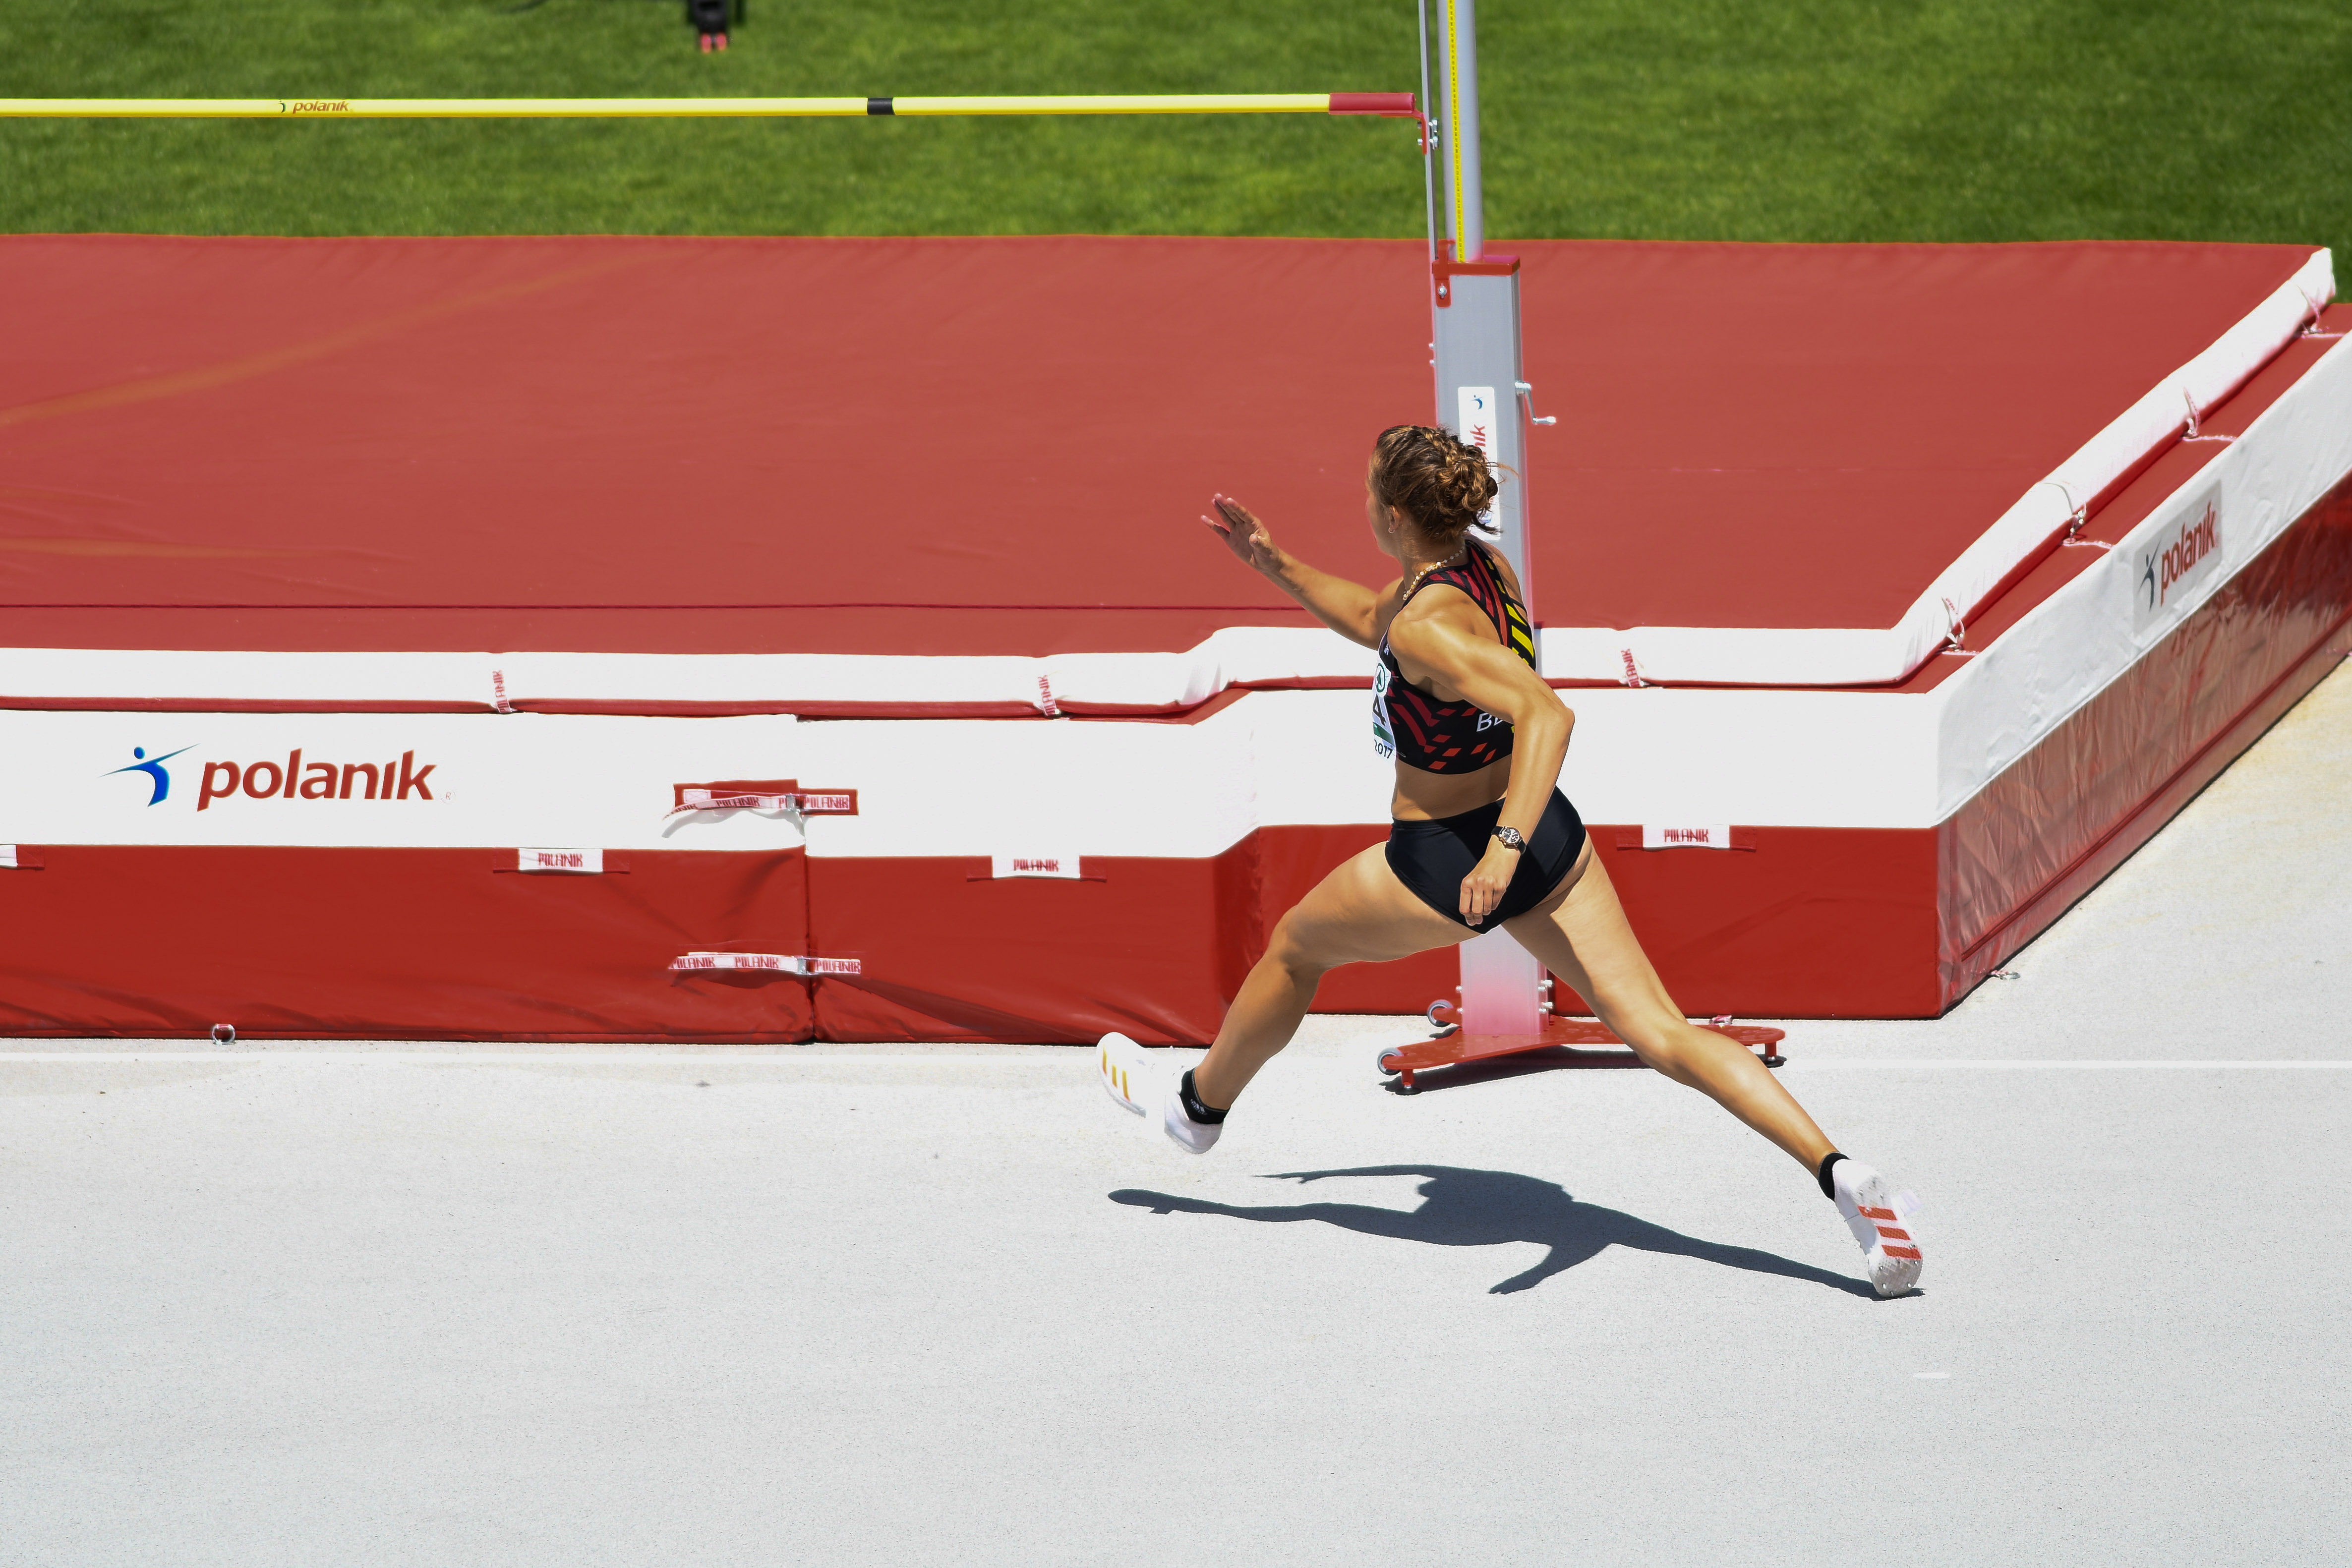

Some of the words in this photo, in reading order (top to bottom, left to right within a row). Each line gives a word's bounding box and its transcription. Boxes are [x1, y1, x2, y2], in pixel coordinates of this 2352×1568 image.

[293, 100, 349, 114] polanik
[2161, 500, 2216, 607] polanik
[197, 748, 437, 812] polanik
[716, 796, 760, 807] POLANIK
[1664, 828, 1708, 843] POLANIK
[538, 853, 583, 868] POLANIK
[1013, 859, 1058, 872] POLANIK
[735, 955, 779, 969] POLANIK
